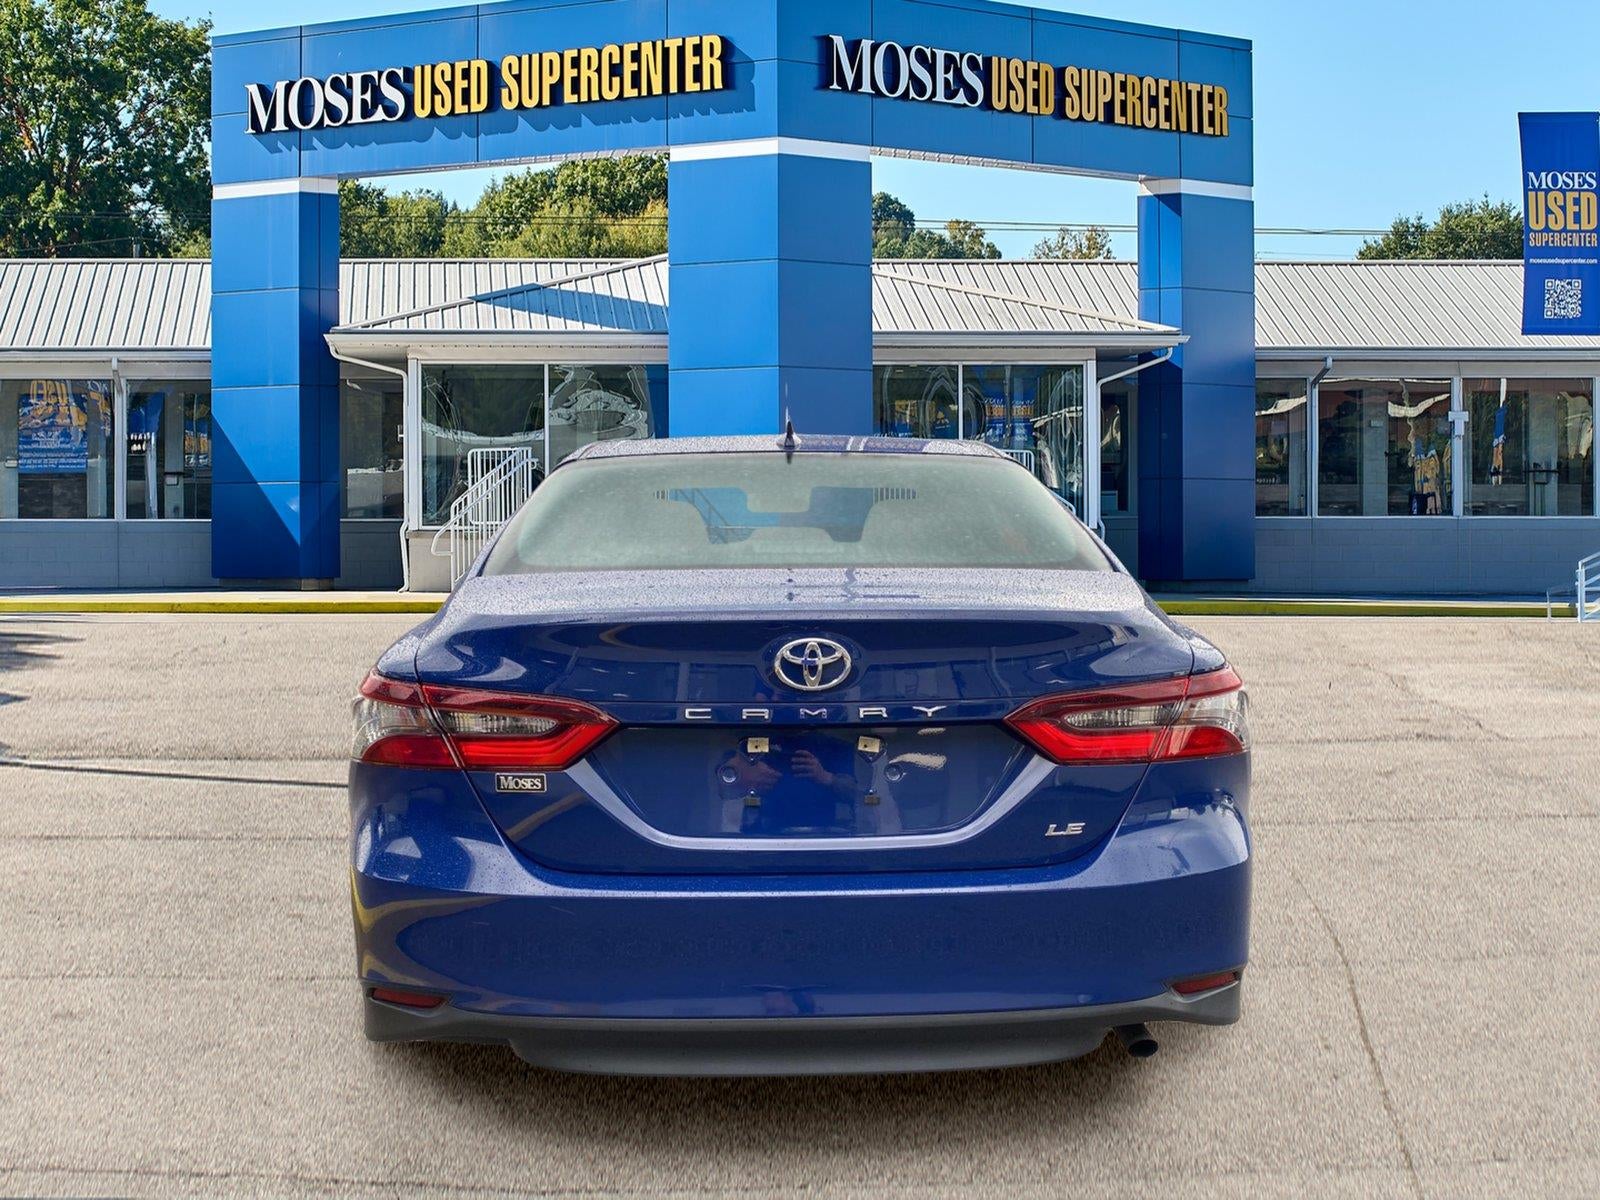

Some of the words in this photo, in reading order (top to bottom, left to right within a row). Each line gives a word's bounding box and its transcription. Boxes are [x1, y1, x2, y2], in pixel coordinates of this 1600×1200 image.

[244, 67, 408, 134] MOSES
[413, 59, 488, 118] USED
[500, 34, 723, 110] SUPERCENTER
[829, 34, 984, 107] MOSES
[991, 56, 1054, 115] USED
[1065, 66, 1229, 136] SUPERCENTER
[1527, 171, 1597, 190] MOSES
[1528, 190, 1597, 230] USED
[1529, 232, 1597, 247] SUPERCENTER
[685, 705, 947, 719] CAMRY
[500, 776, 541, 789] MOSES
[1045, 822, 1086, 836] LE
